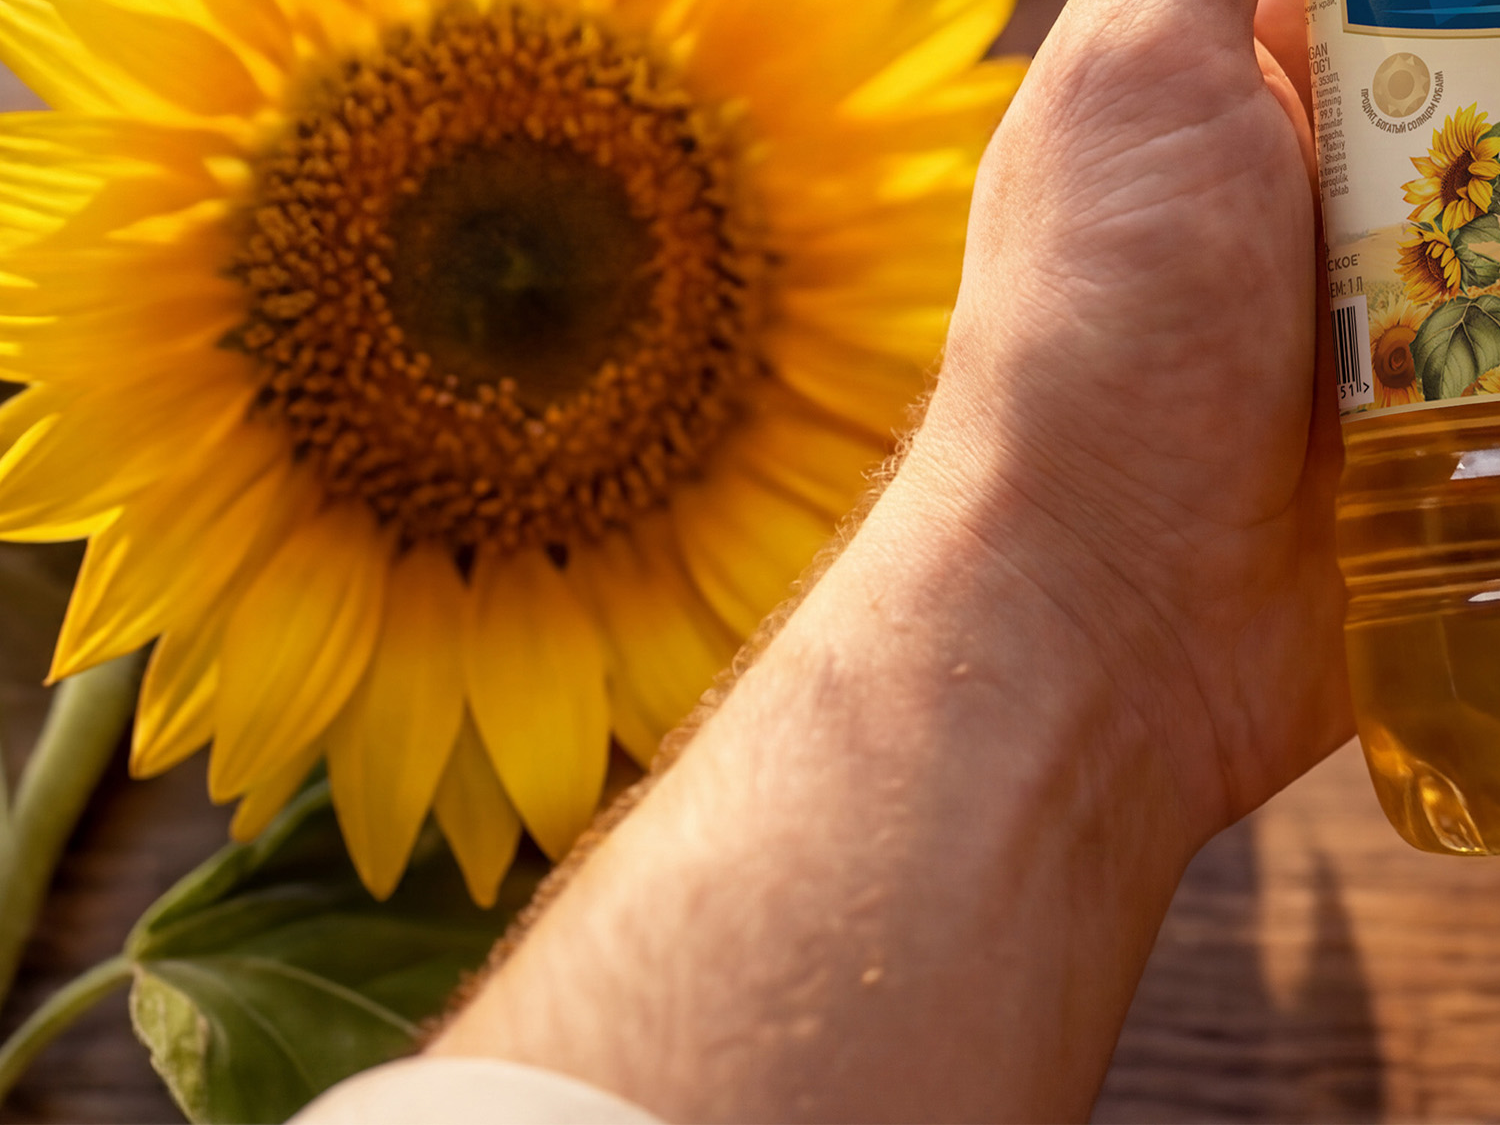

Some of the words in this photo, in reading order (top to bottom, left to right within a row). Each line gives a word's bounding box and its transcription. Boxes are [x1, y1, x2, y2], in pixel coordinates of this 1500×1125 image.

[1375, 118, 1407, 134] БОГАТЫЙ
[1407, 102, 1439, 132] СОЛНЦЕМ
[1432, 70, 1445, 104] КУБАНИ
